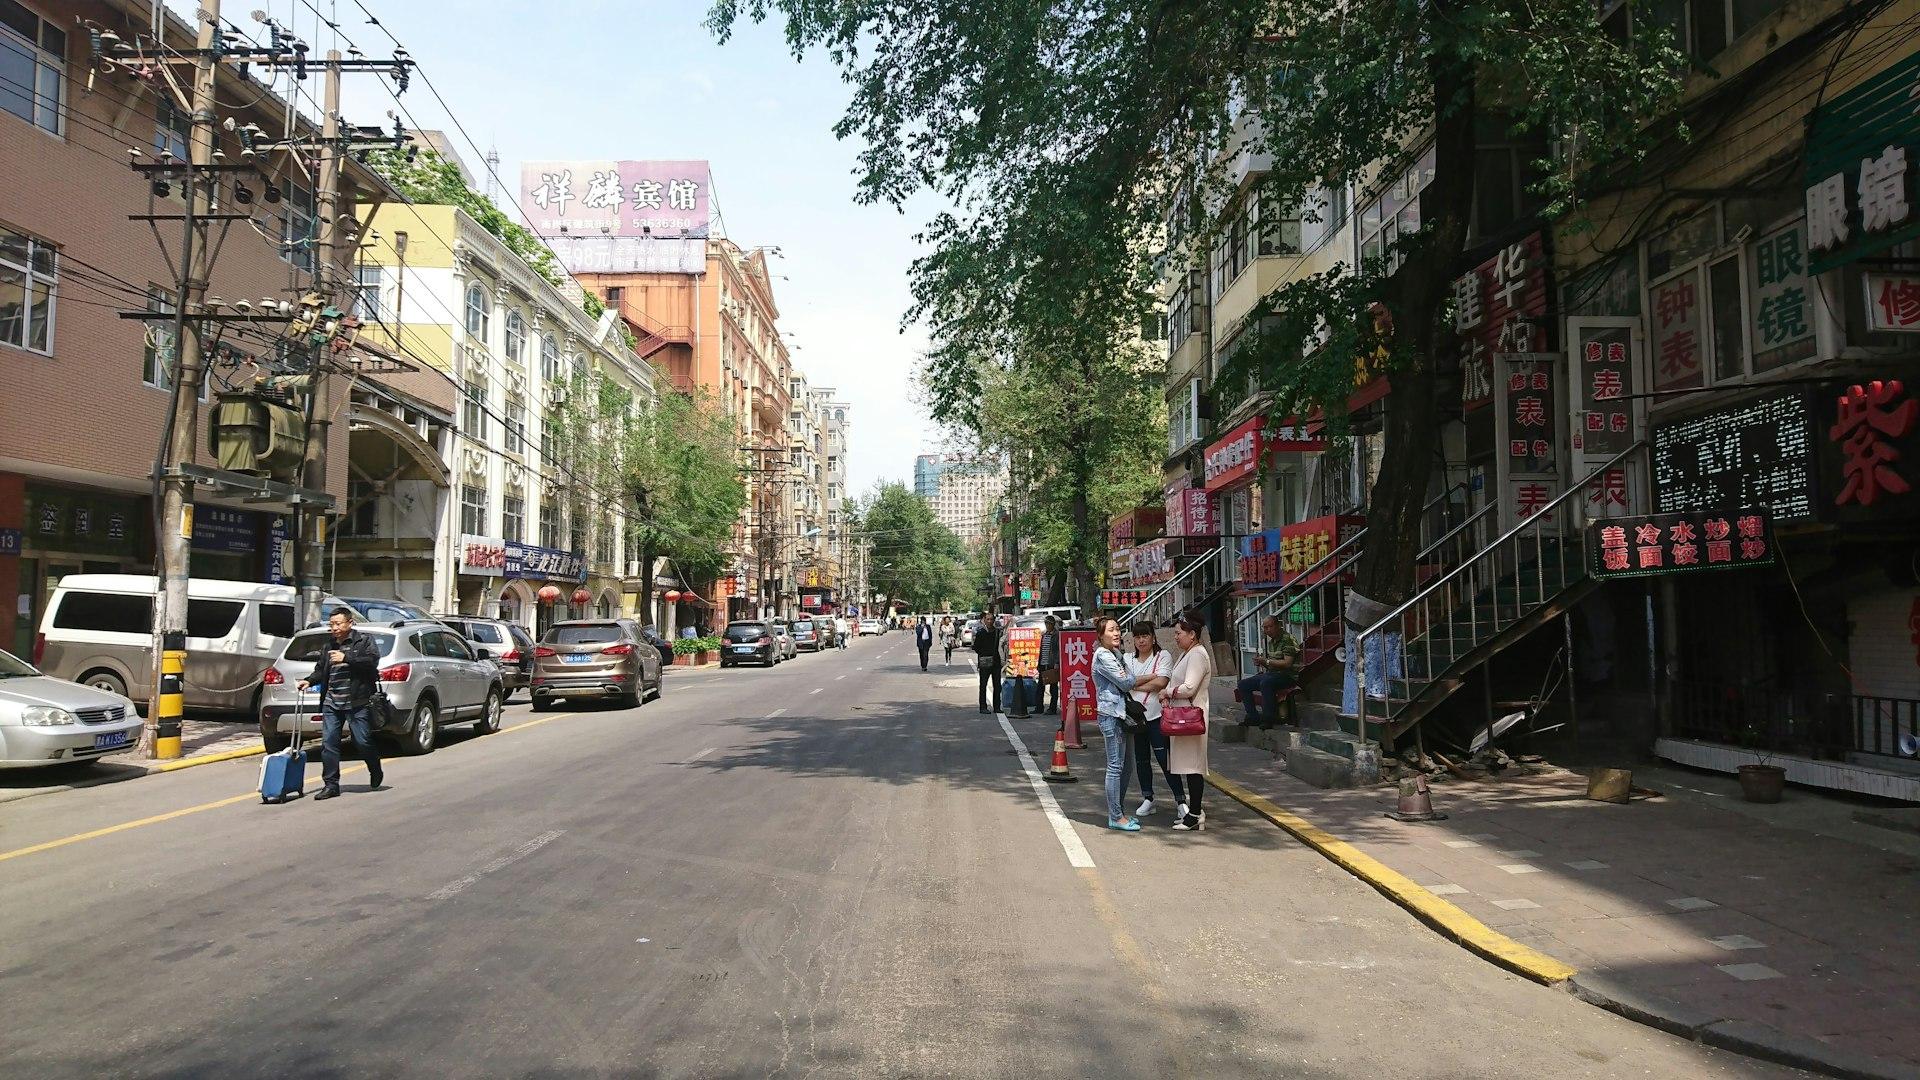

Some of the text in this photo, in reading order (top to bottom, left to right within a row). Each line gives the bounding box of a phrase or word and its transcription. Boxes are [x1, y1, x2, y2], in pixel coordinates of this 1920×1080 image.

[531, 169, 700, 216] 祥麟宾馆
[1806, 144, 1909, 251] 眼镜
[1756, 227, 1808, 345] 眼镜
[1656, 279, 1698, 378] 钟表
[1584, 341, 1627, 363] 修表
[1509, 371, 1549, 391] 修表
[1592, 369, 1624, 402] 表
[1515, 396, 1547, 427] 表
[1586, 412, 1628, 433] 配件
[1510, 438, 1550, 458] 配件
[1190, 489, 1208, 534] 招待所
